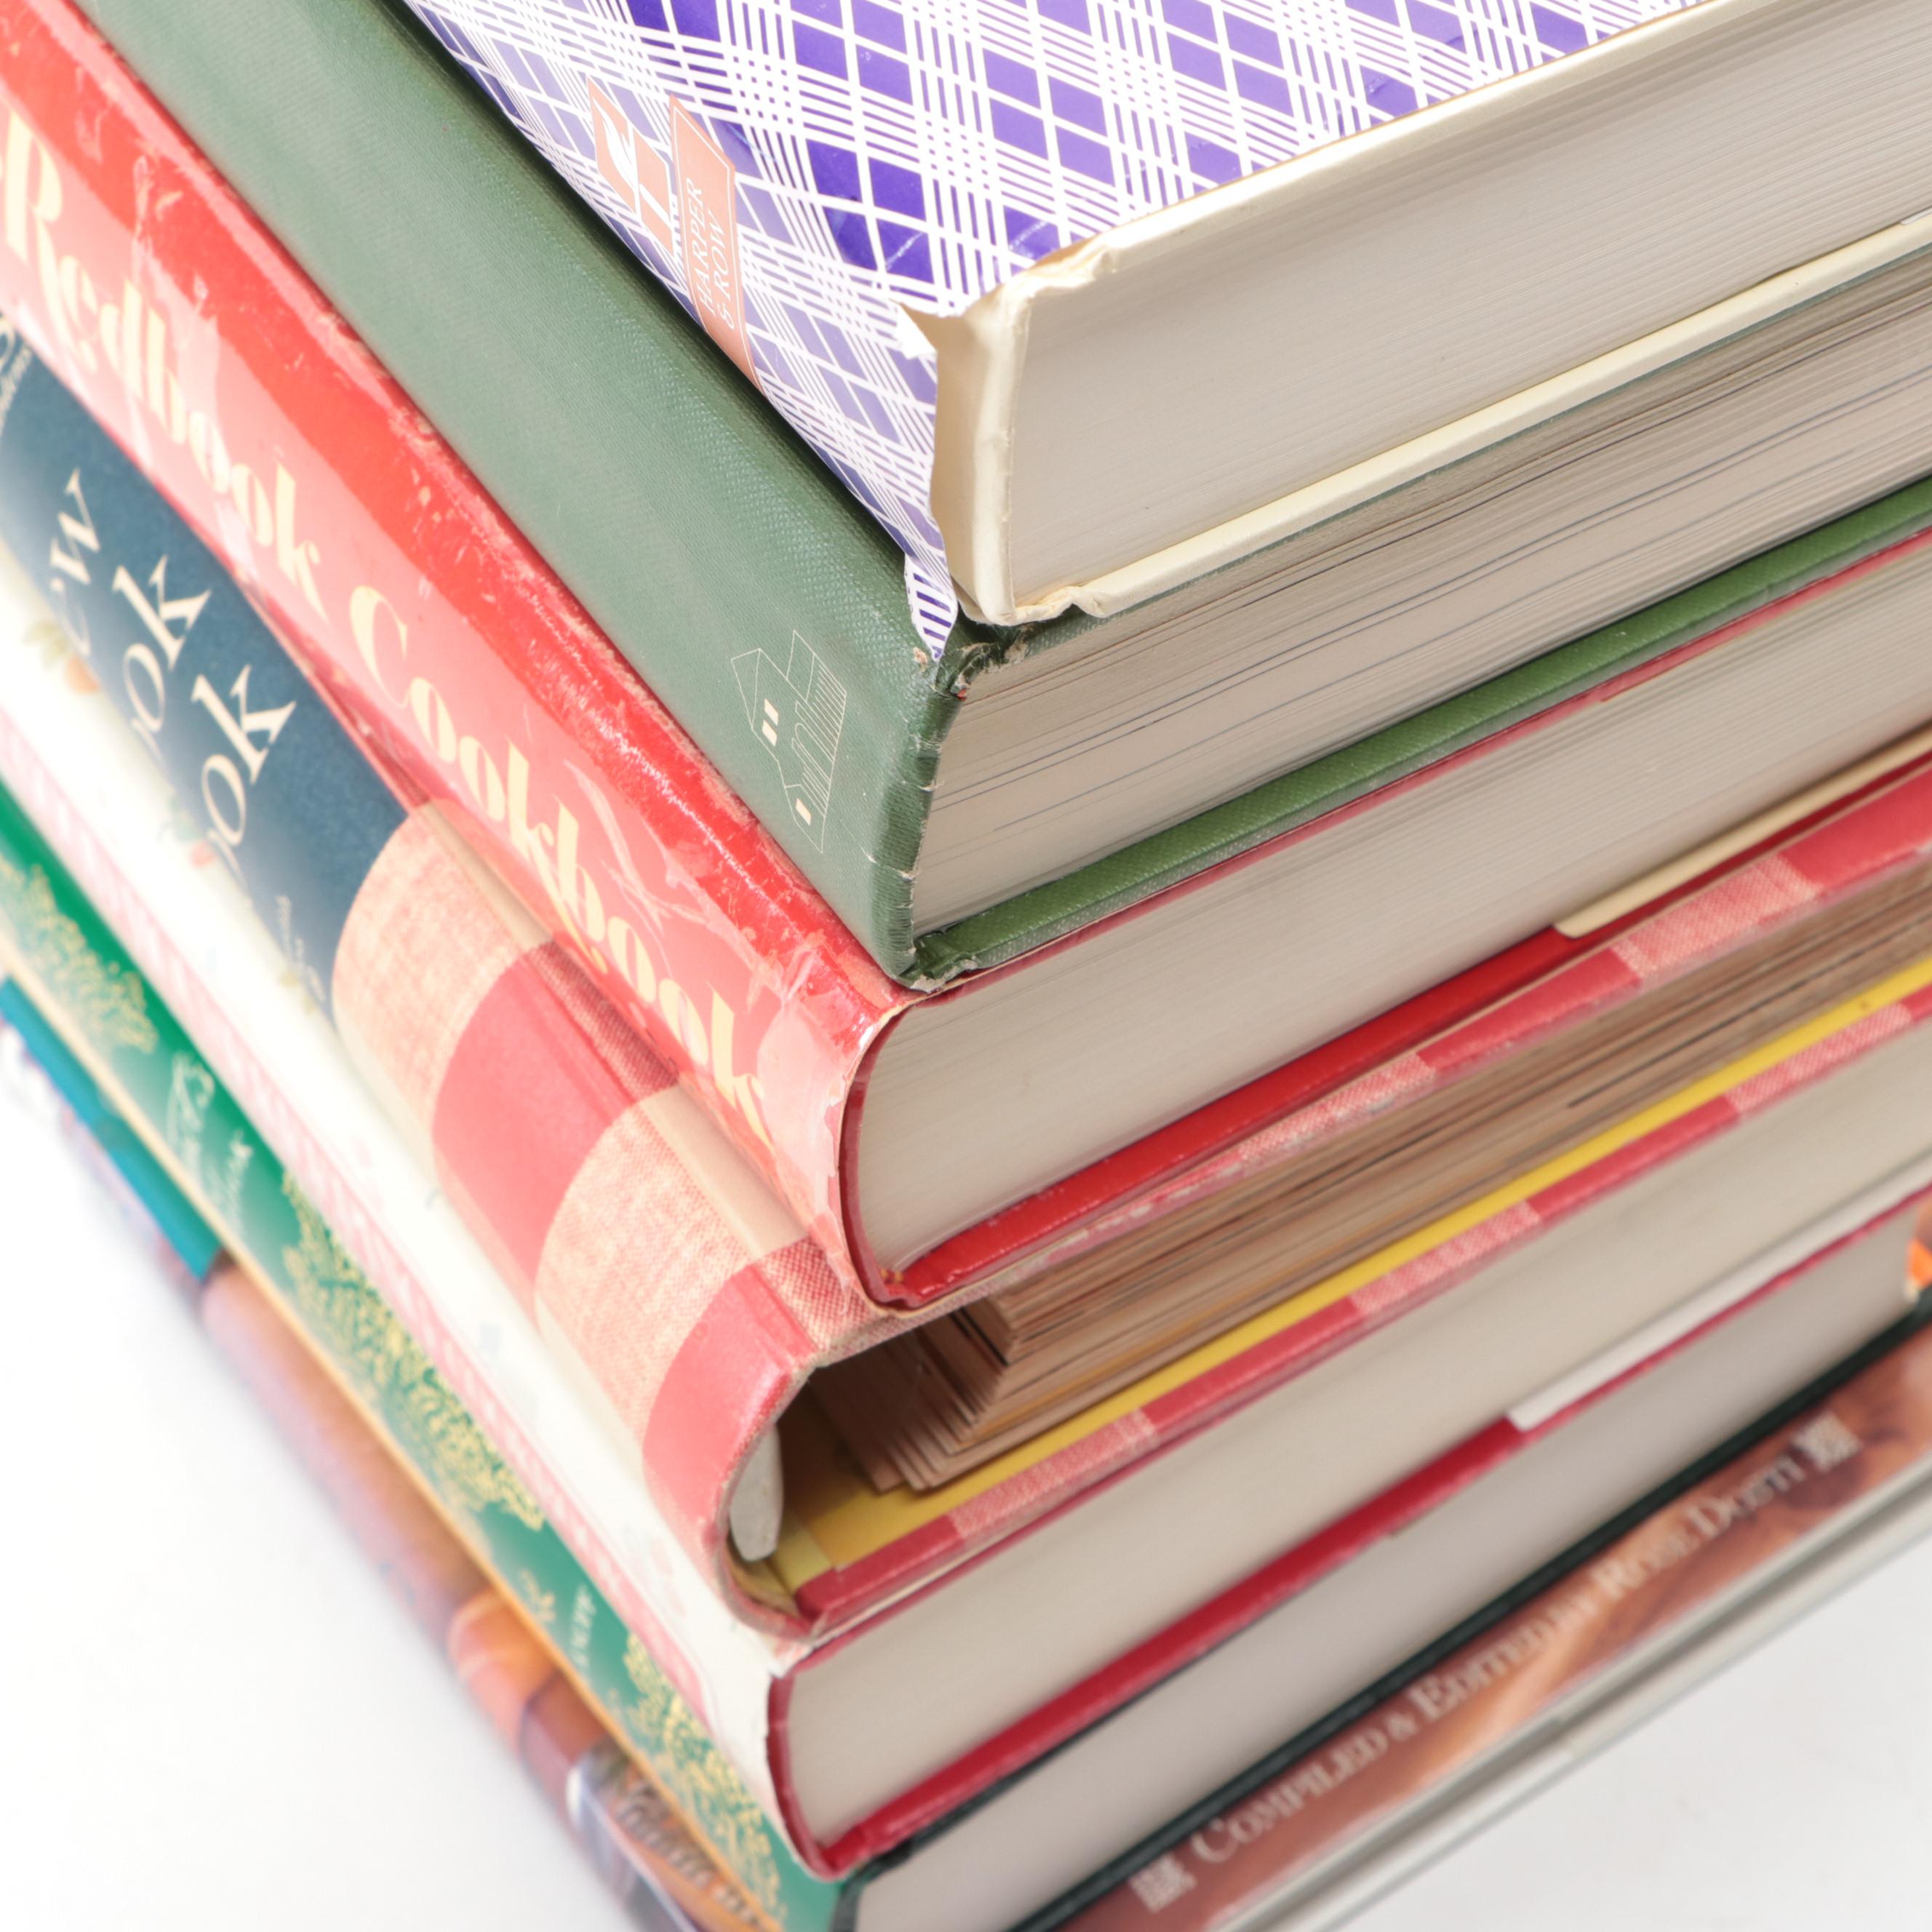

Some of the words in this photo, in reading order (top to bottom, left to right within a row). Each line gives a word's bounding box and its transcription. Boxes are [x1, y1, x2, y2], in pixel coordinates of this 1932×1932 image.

[685, 177, 716, 319] HARPER
[707, 208, 731, 302] ROW
[716, 301, 735, 330] &
[0, 106, 330, 623] Redbook
[349, 585, 775, 1157] Cookbook
